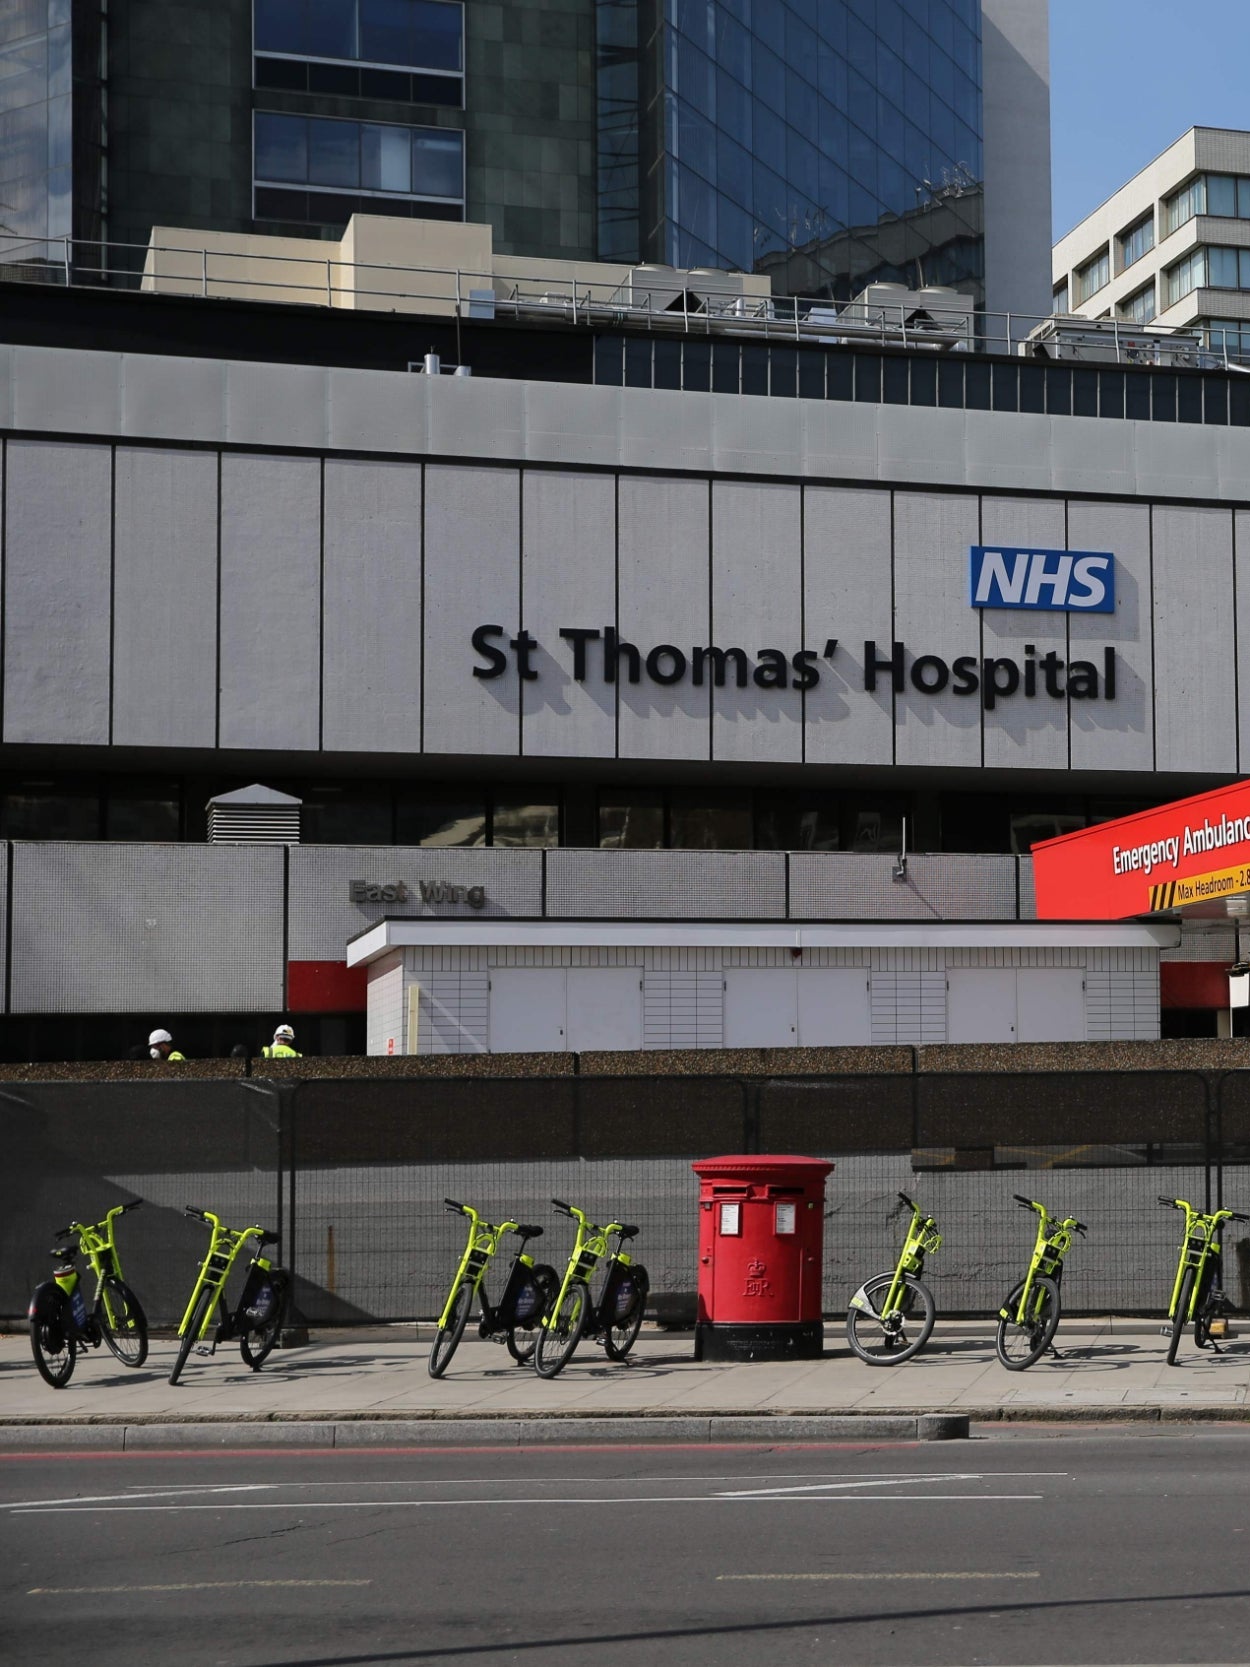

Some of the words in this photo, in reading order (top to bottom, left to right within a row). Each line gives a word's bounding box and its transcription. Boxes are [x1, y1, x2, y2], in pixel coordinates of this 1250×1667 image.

[974, 551, 1109, 607] NHS
[471, 624, 538, 681] St
[863, 640, 1116, 710] Hospital
[1113, 835, 1180, 875] Emergency
[349, 880, 408, 902] East
[419, 880, 484, 909] Wing
[1178, 885, 1194, 901] Max
[1195, 876, 1234, 896] Headroom
